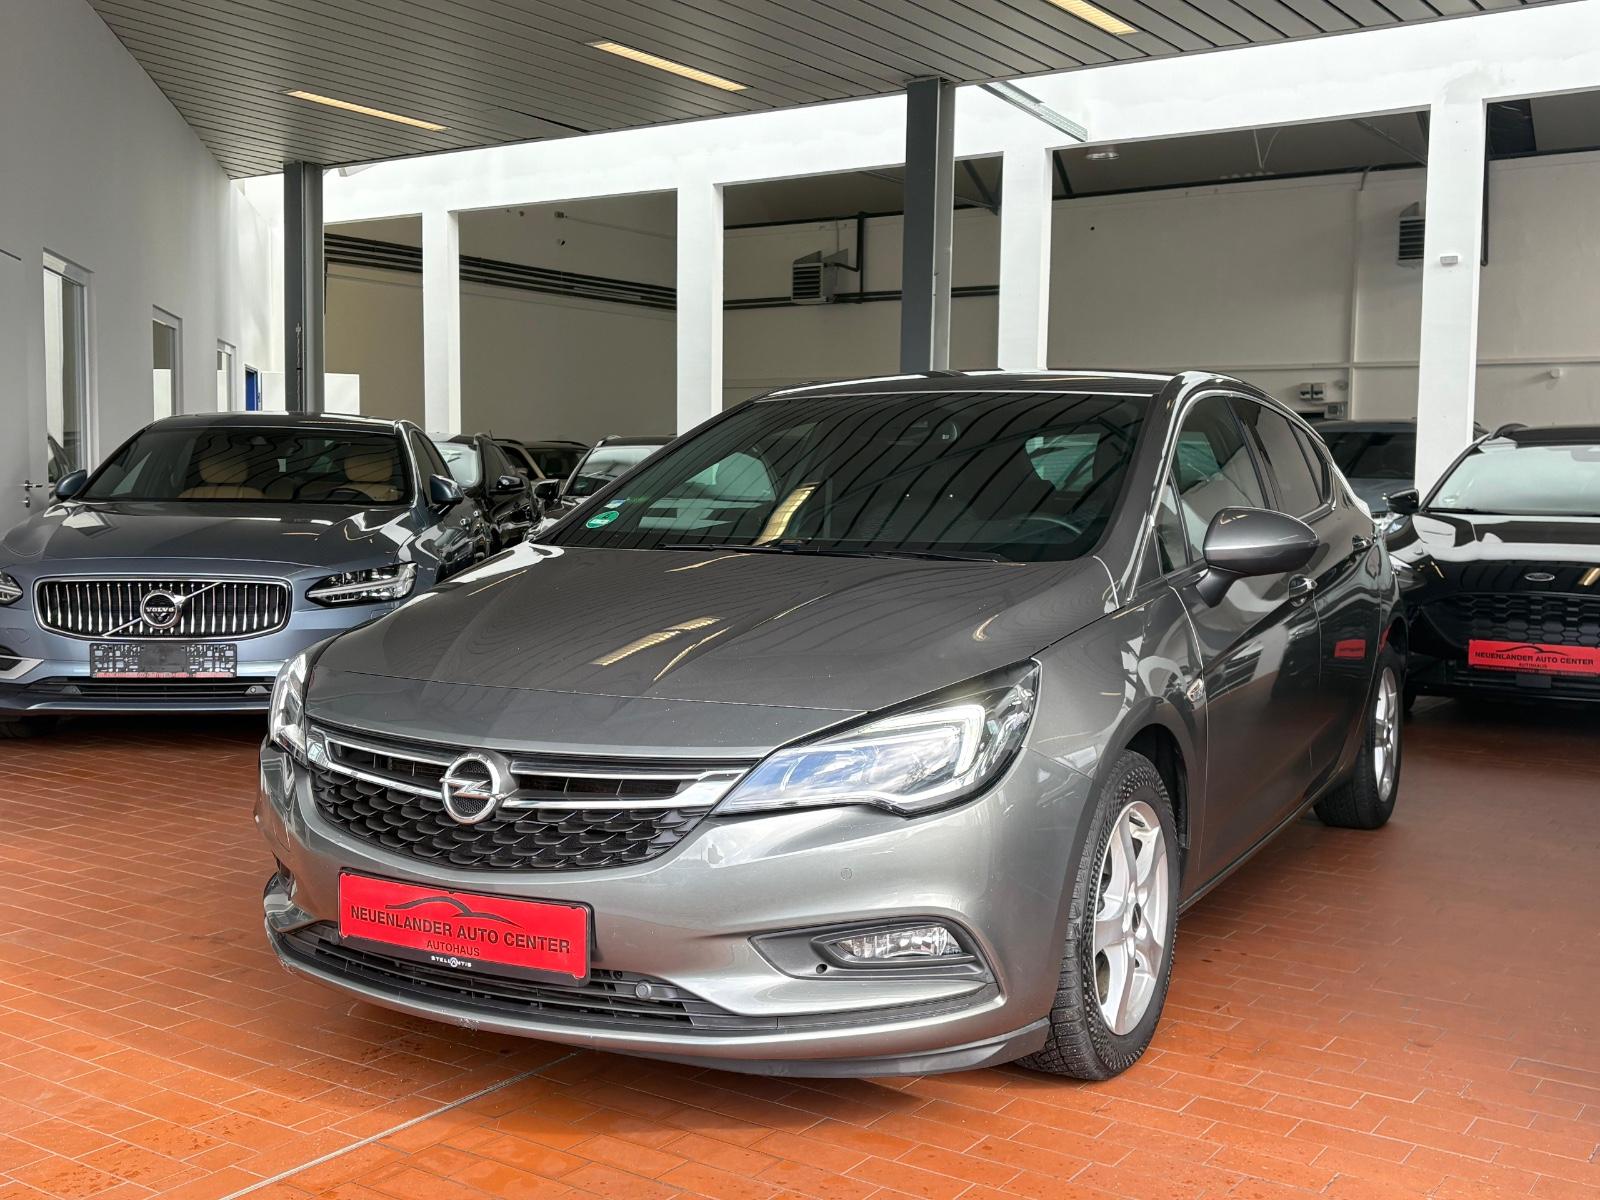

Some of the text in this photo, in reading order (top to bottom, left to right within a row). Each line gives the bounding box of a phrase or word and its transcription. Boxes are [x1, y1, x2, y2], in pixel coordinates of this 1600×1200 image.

[1475, 651, 1594, 665] NEUENLANDER AUTO CENTER
[351, 905, 570, 954] NEUENLANDER AUTO CENTER
[426, 939, 480, 957] AUTOHAUS
[431, 955, 472, 967] STELLANTIS
